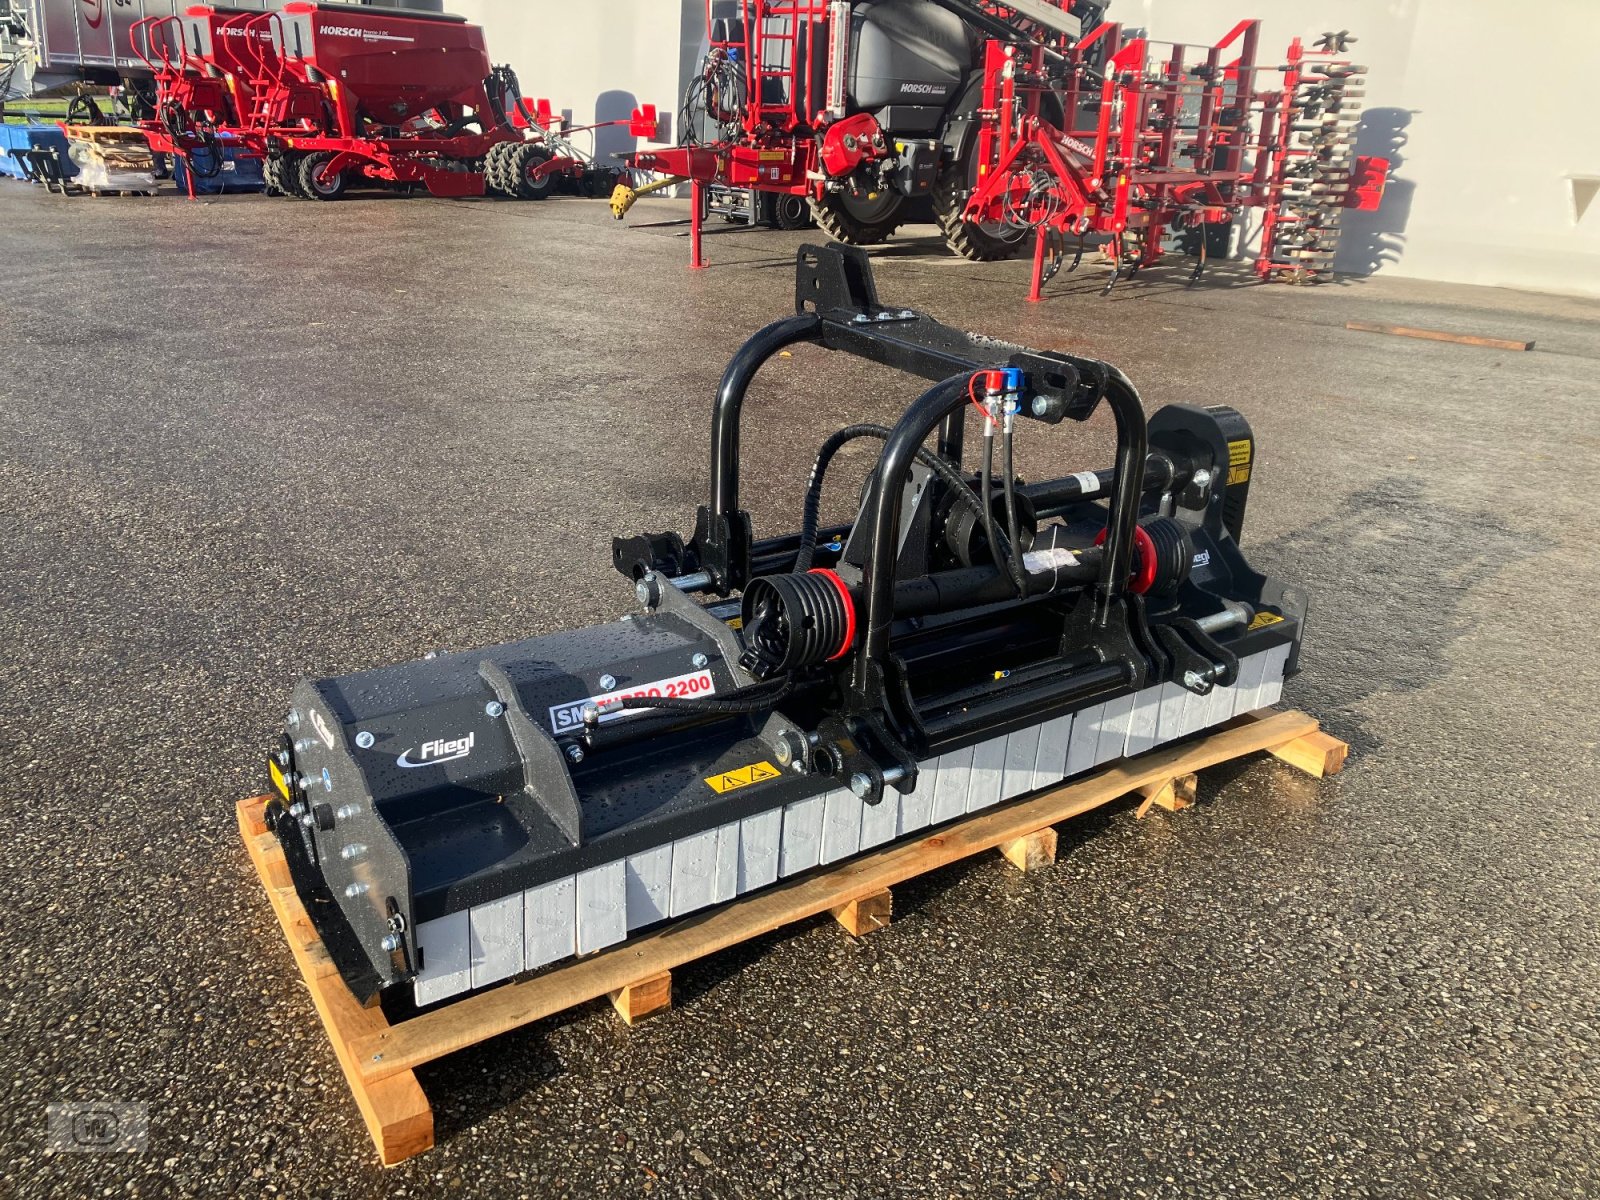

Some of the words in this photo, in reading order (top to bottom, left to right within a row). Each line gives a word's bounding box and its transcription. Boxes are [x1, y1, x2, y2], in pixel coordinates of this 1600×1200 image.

[320, 25, 362, 37] HORSCH
[900, 83, 933, 93] HORSCH
[1061, 135, 1094, 157] HORSCH
[666, 675, 711, 698] 2200
[421, 731, 475, 760] Fliegl
